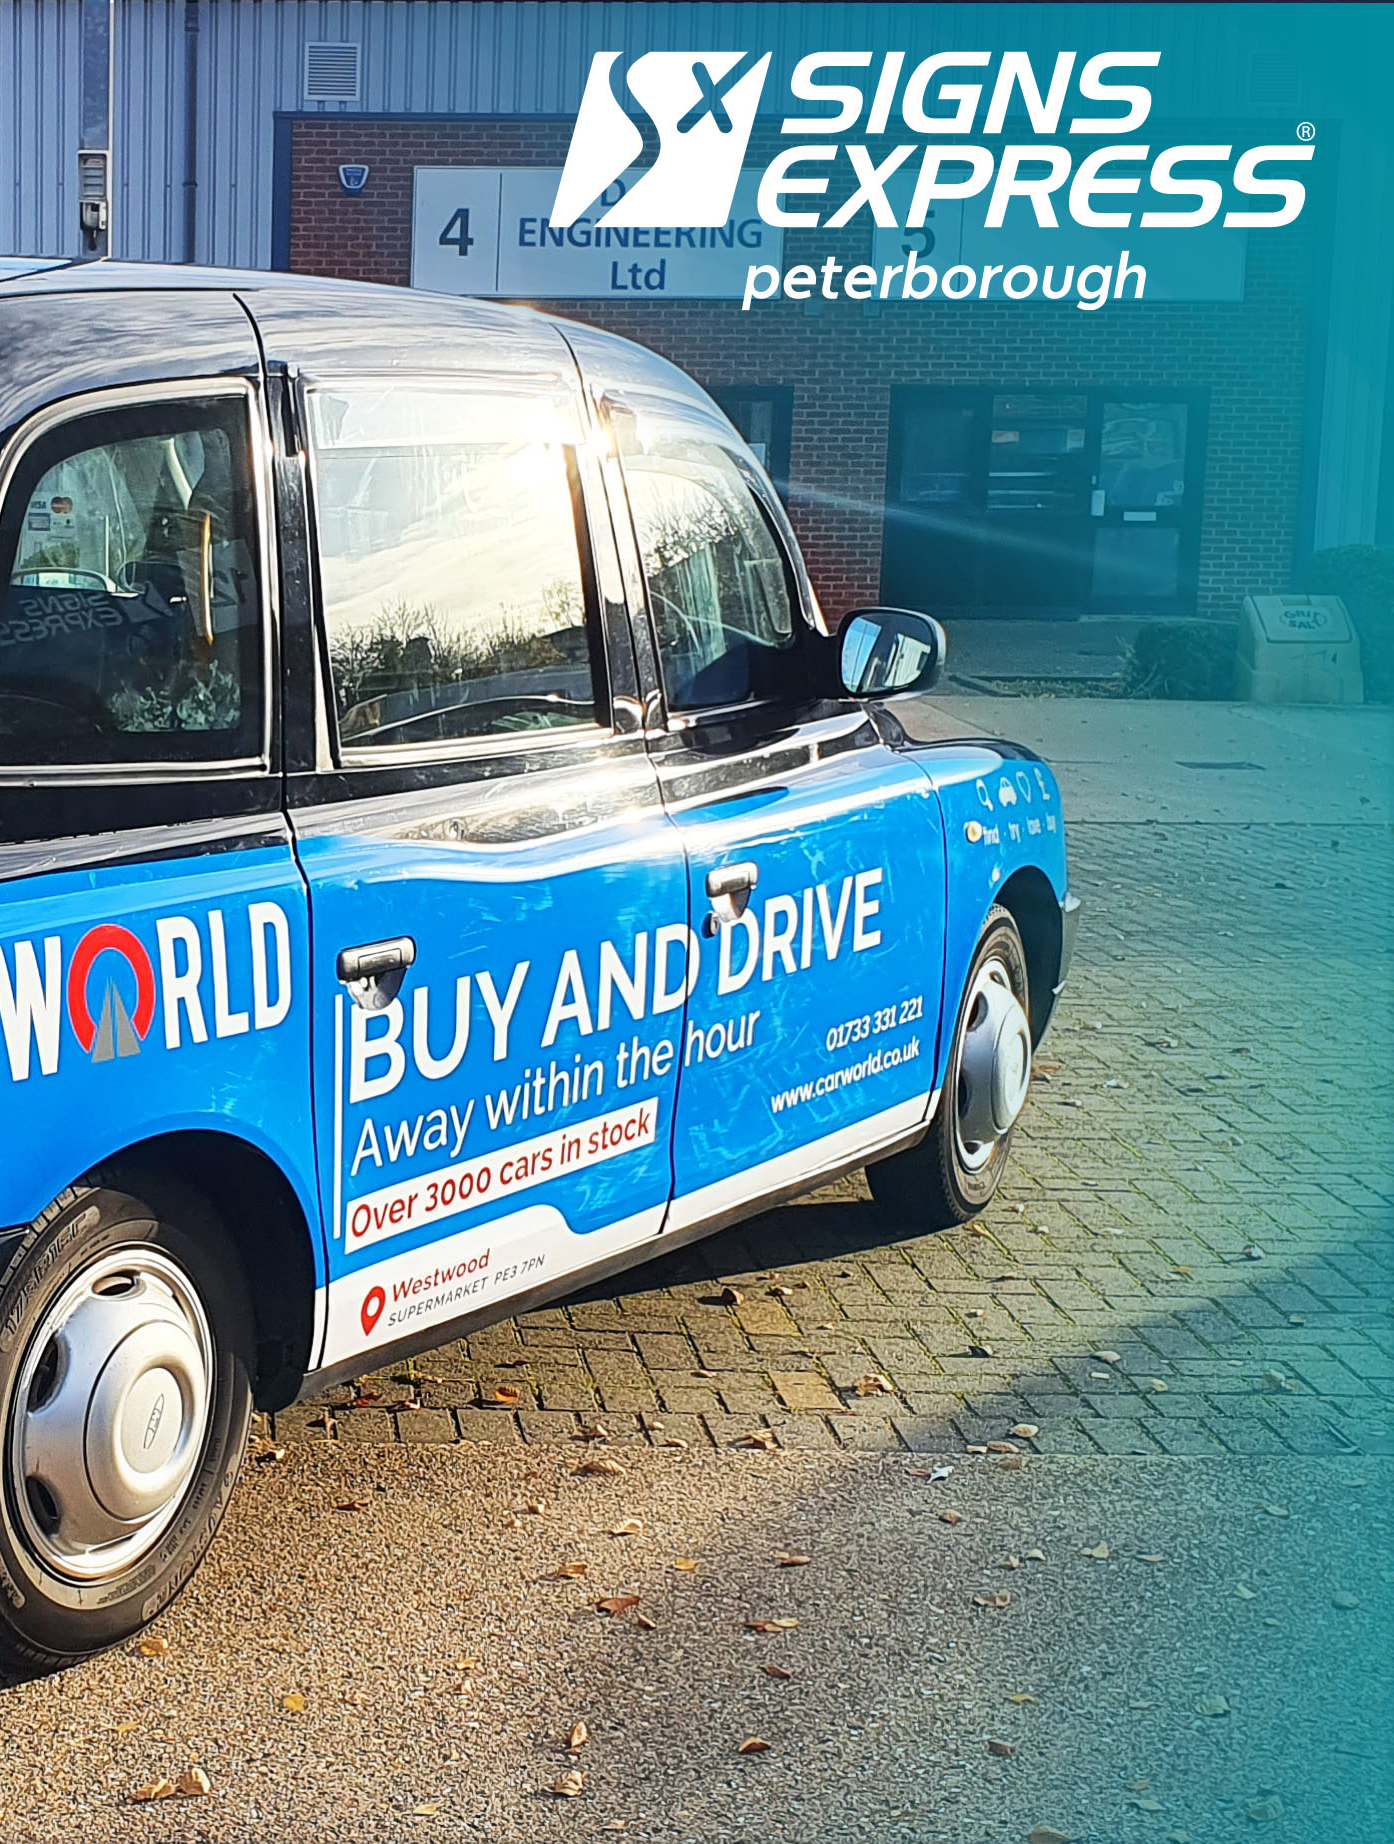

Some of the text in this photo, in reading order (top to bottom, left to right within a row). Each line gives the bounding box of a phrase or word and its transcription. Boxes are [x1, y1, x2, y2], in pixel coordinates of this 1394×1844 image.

[439, 208, 762, 256] 4 ENGINEERING
[901, 210, 936, 258] 5
[610, 259, 666, 291] Ltd
[349, 867, 883, 1105] BUY AND DRIVE
[826, 995, 924, 1051] 01733 331 221
[350, 1010, 761, 1177] Away within the hour
[771, 1036, 920, 1113] www.carworld.co.uk
[351, 1106, 651, 1238] Over 3000 cars in stock
[387, 1254, 545, 1327] SUPERMARKET PE3 7PN
[391, 1248, 490, 1302] Westwood
